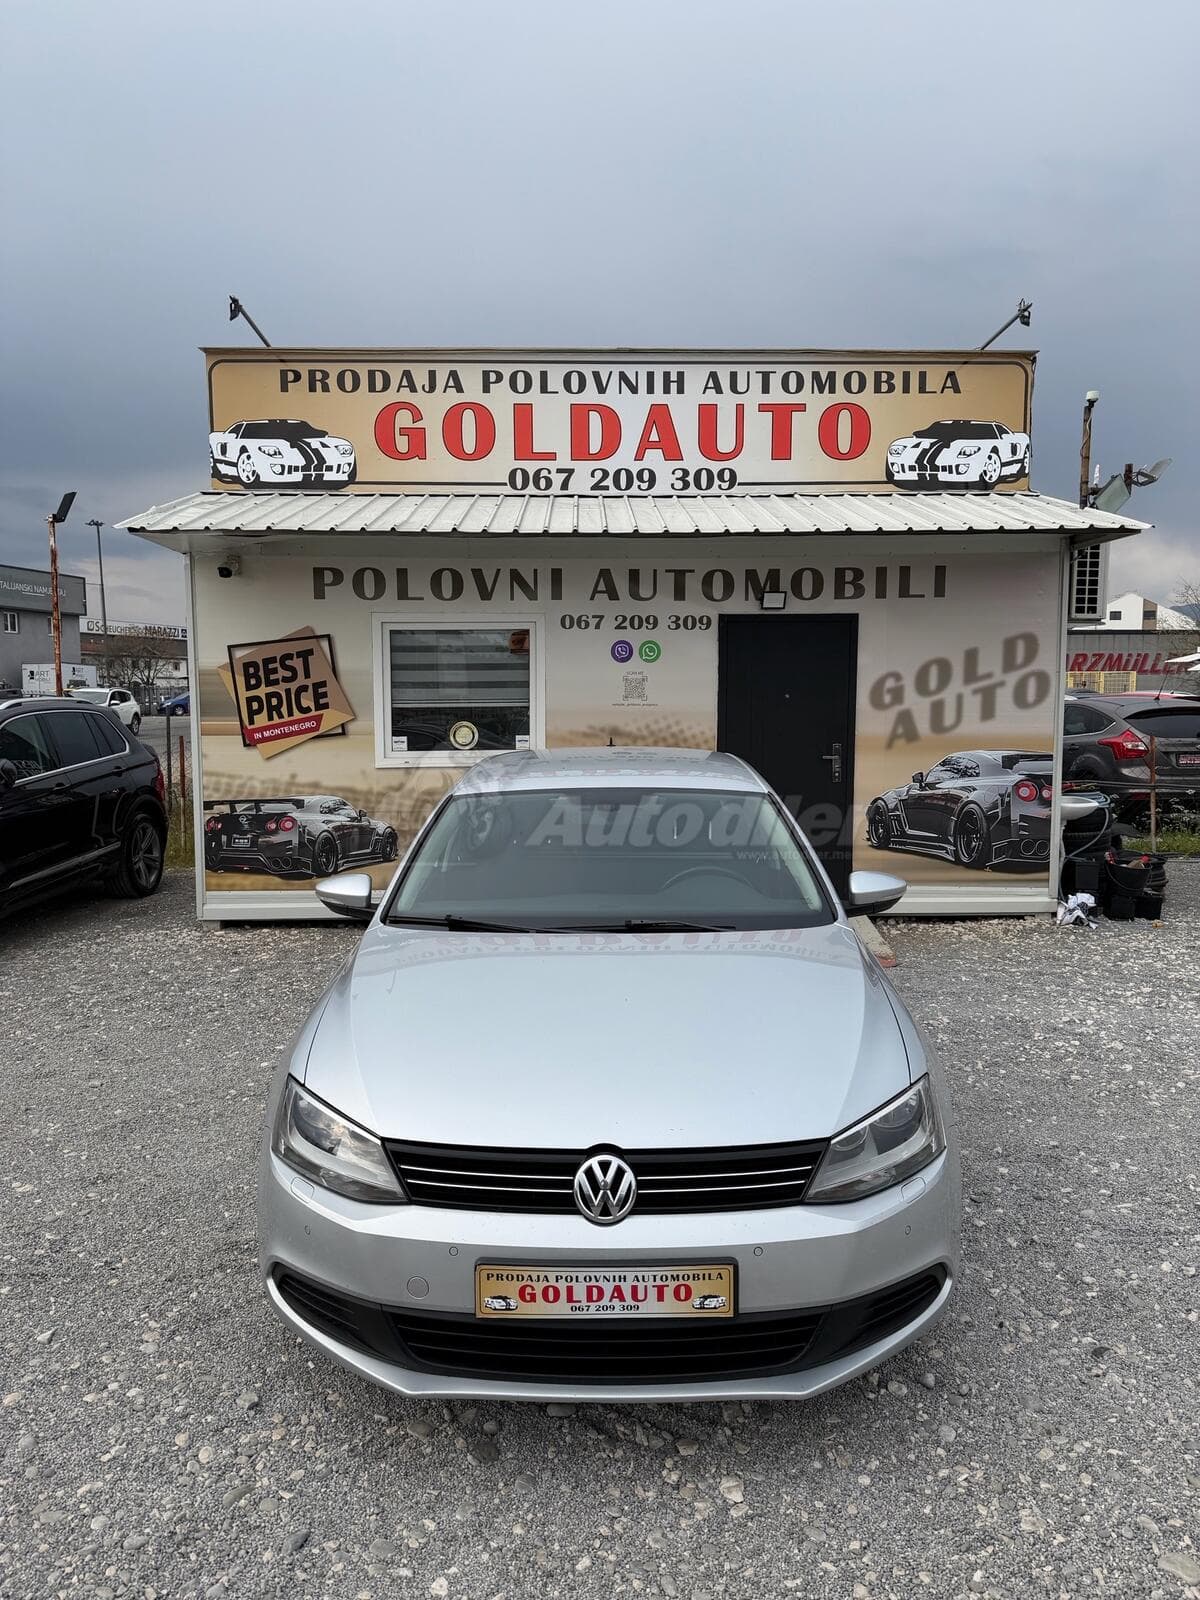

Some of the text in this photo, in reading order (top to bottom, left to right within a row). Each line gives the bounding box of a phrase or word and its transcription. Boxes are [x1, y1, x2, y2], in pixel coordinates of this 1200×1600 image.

[279, 369, 961, 394] PRODAJA POLOVNIH AUTOMOBILA
[374, 401, 871, 461] GOLDAUTO
[508, 468, 738, 491] 067 209 309
[312, 565, 947, 602] POLOVNI AUTOMOBILI
[560, 614, 712, 630] 067 209 309
[242, 648, 314, 692] BEST
[869, 631, 1040, 711] GOLD
[245, 680, 329, 726] PRICE
[885, 669, 1051, 750] AUTO
[254, 720, 317, 740] IN MONTENEGRO
[486, 1272, 723, 1283] PRODAJA POLOVNIH AUTOMOBILA
[518, 1283, 693, 1304] GOLDAUTO
